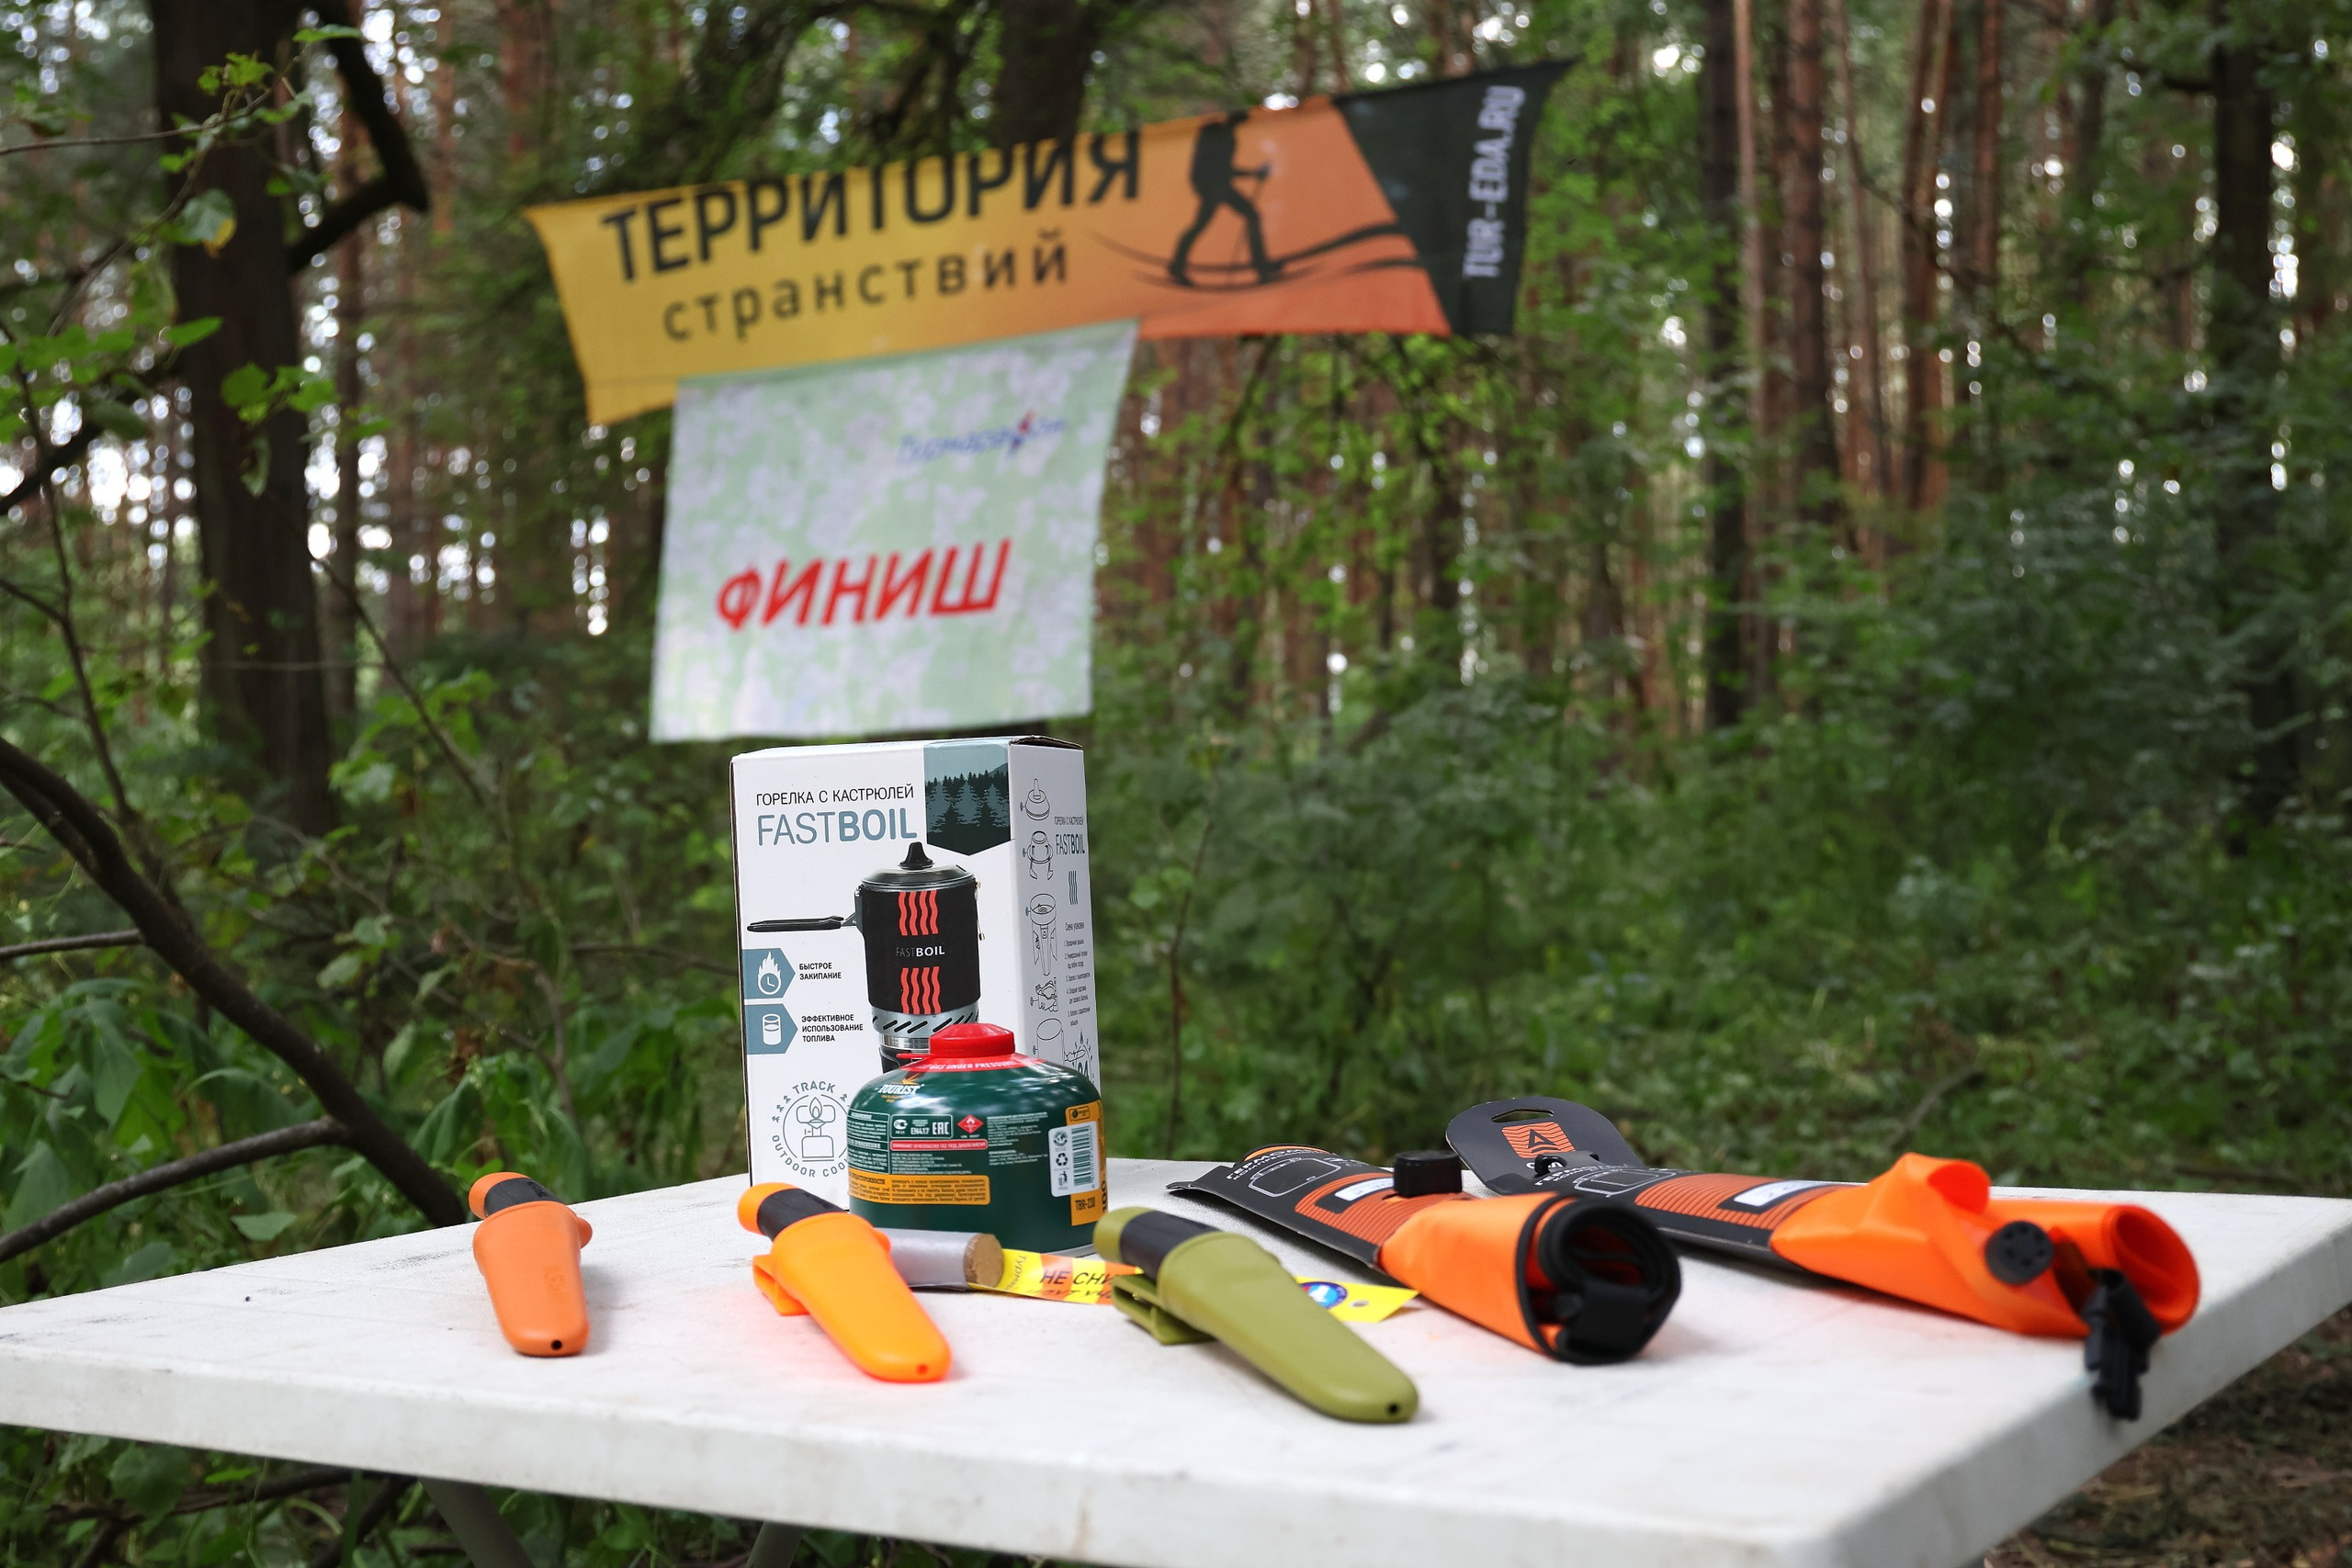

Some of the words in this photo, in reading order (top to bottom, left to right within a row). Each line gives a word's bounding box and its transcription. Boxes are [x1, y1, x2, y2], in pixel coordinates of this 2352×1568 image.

[1462, 85, 1524, 278] TUR-EDA.RU
[601, 130, 1139, 283] ТЕРРИТОРИЯ
[662, 228, 1068, 341] странствий
[717, 536, 1011, 631] ФИНИШ
[756, 792, 814, 806] ГОРЕЛКА
[819, 790, 828, 803] С
[832, 784, 914, 802] КАСТРЮЛЕЙ
[758, 807, 917, 846] FASTBOIL
[1056, 834, 1085, 854] FASTBOIL
[896, 945, 945, 957] FASTBOIL
[799, 972, 842, 980] ЗАКИПАНИЕ
[801, 1014, 854, 1022] ЭФФЕКТИВНОЕ
[802, 1024, 864, 1032] ИСПОЛЬЗОВАНИЕ
[792, 1081, 836, 1094] TRACK
[772, 1134, 816, 1178] OUTDOOR
[822, 1158, 848, 1178] COO
[1039, 1269, 1070, 1284] НЕ
